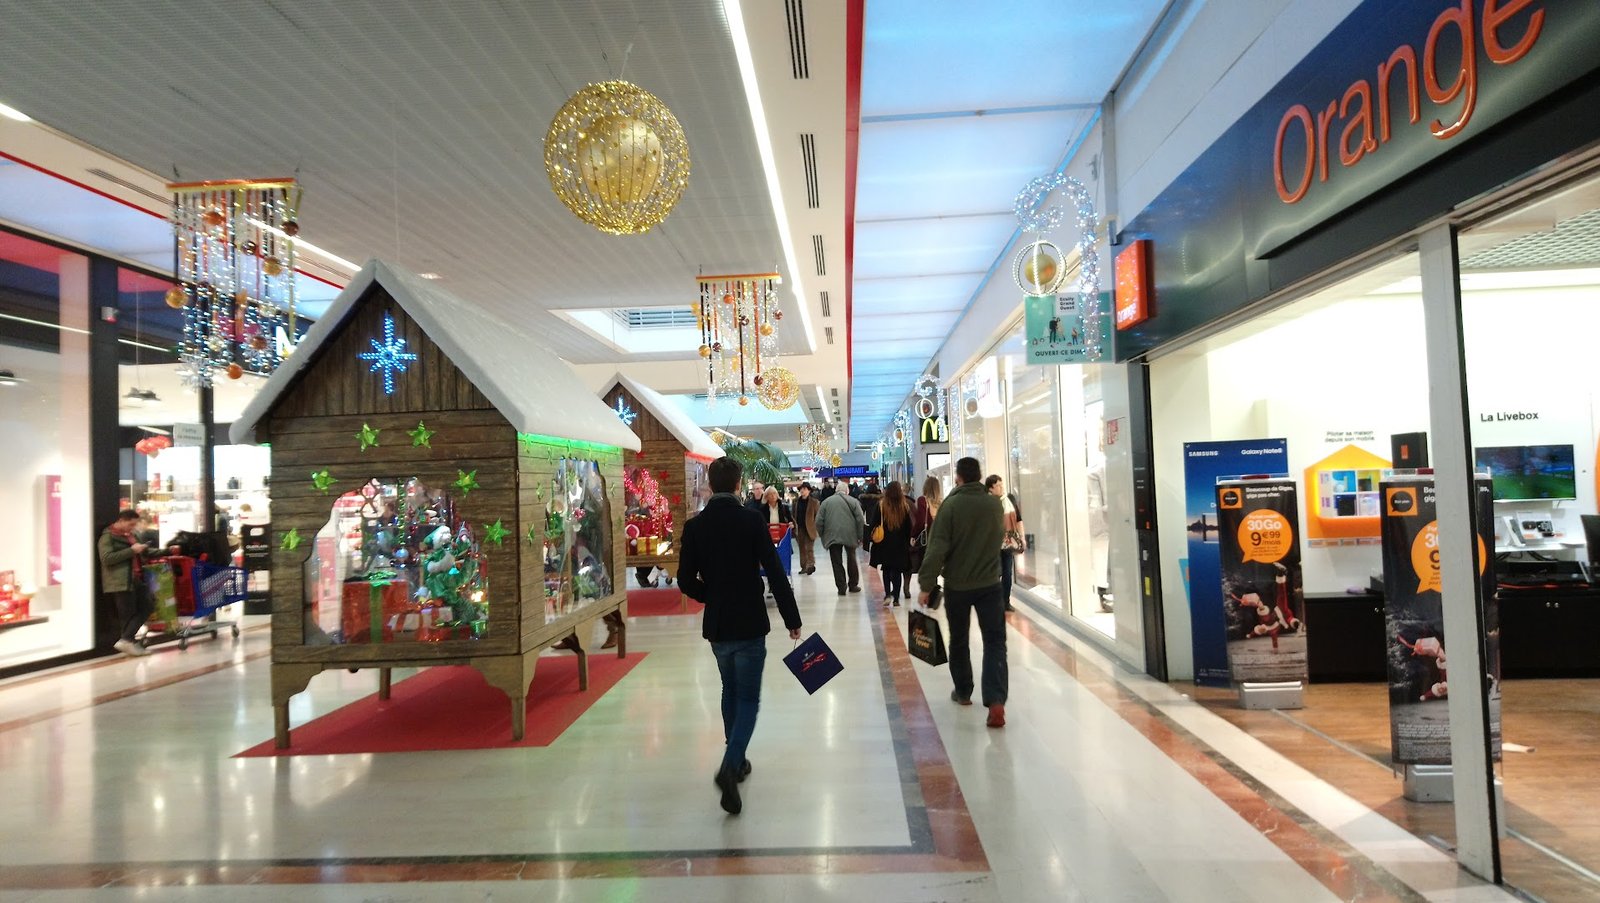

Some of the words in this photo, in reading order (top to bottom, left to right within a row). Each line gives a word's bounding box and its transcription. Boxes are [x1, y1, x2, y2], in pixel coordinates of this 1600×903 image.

[1273, 0, 1546, 205] Orange
[1480, 413, 1493, 422] La
[1497, 411, 1539, 421] Livebox
[1247, 519, 1283, 531] 30Go
[1251, 531, 1262, 546] 9
